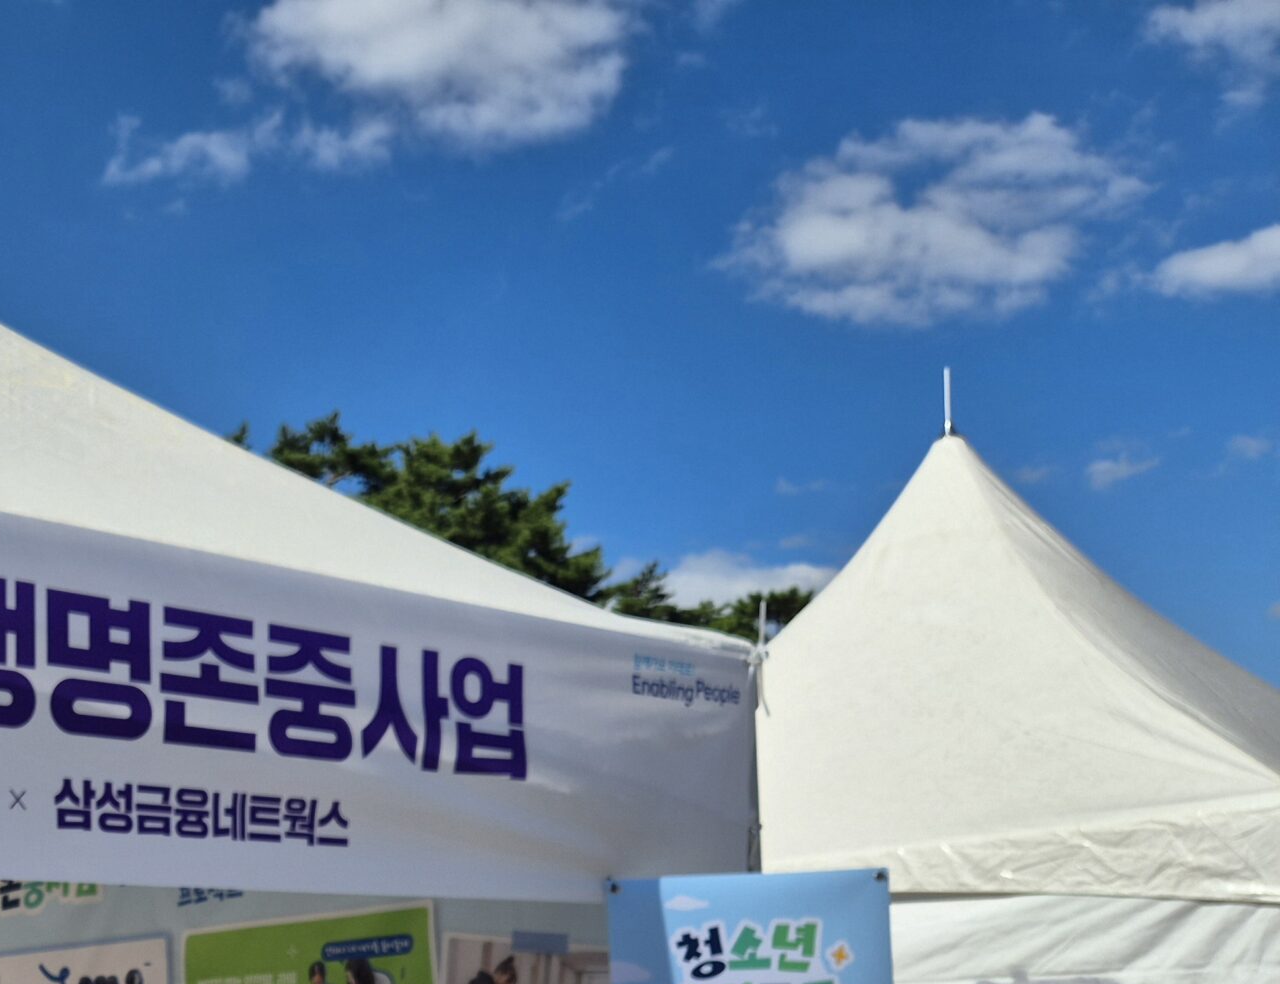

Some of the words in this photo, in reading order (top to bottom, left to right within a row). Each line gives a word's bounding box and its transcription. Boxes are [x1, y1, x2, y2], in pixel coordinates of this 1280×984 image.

[632, 674, 694, 708] Enabling
[696, 678, 740, 707] People
[54, 777, 350, 848] 삼성금융네트웍스
[676, 920, 818, 981] 청소년
